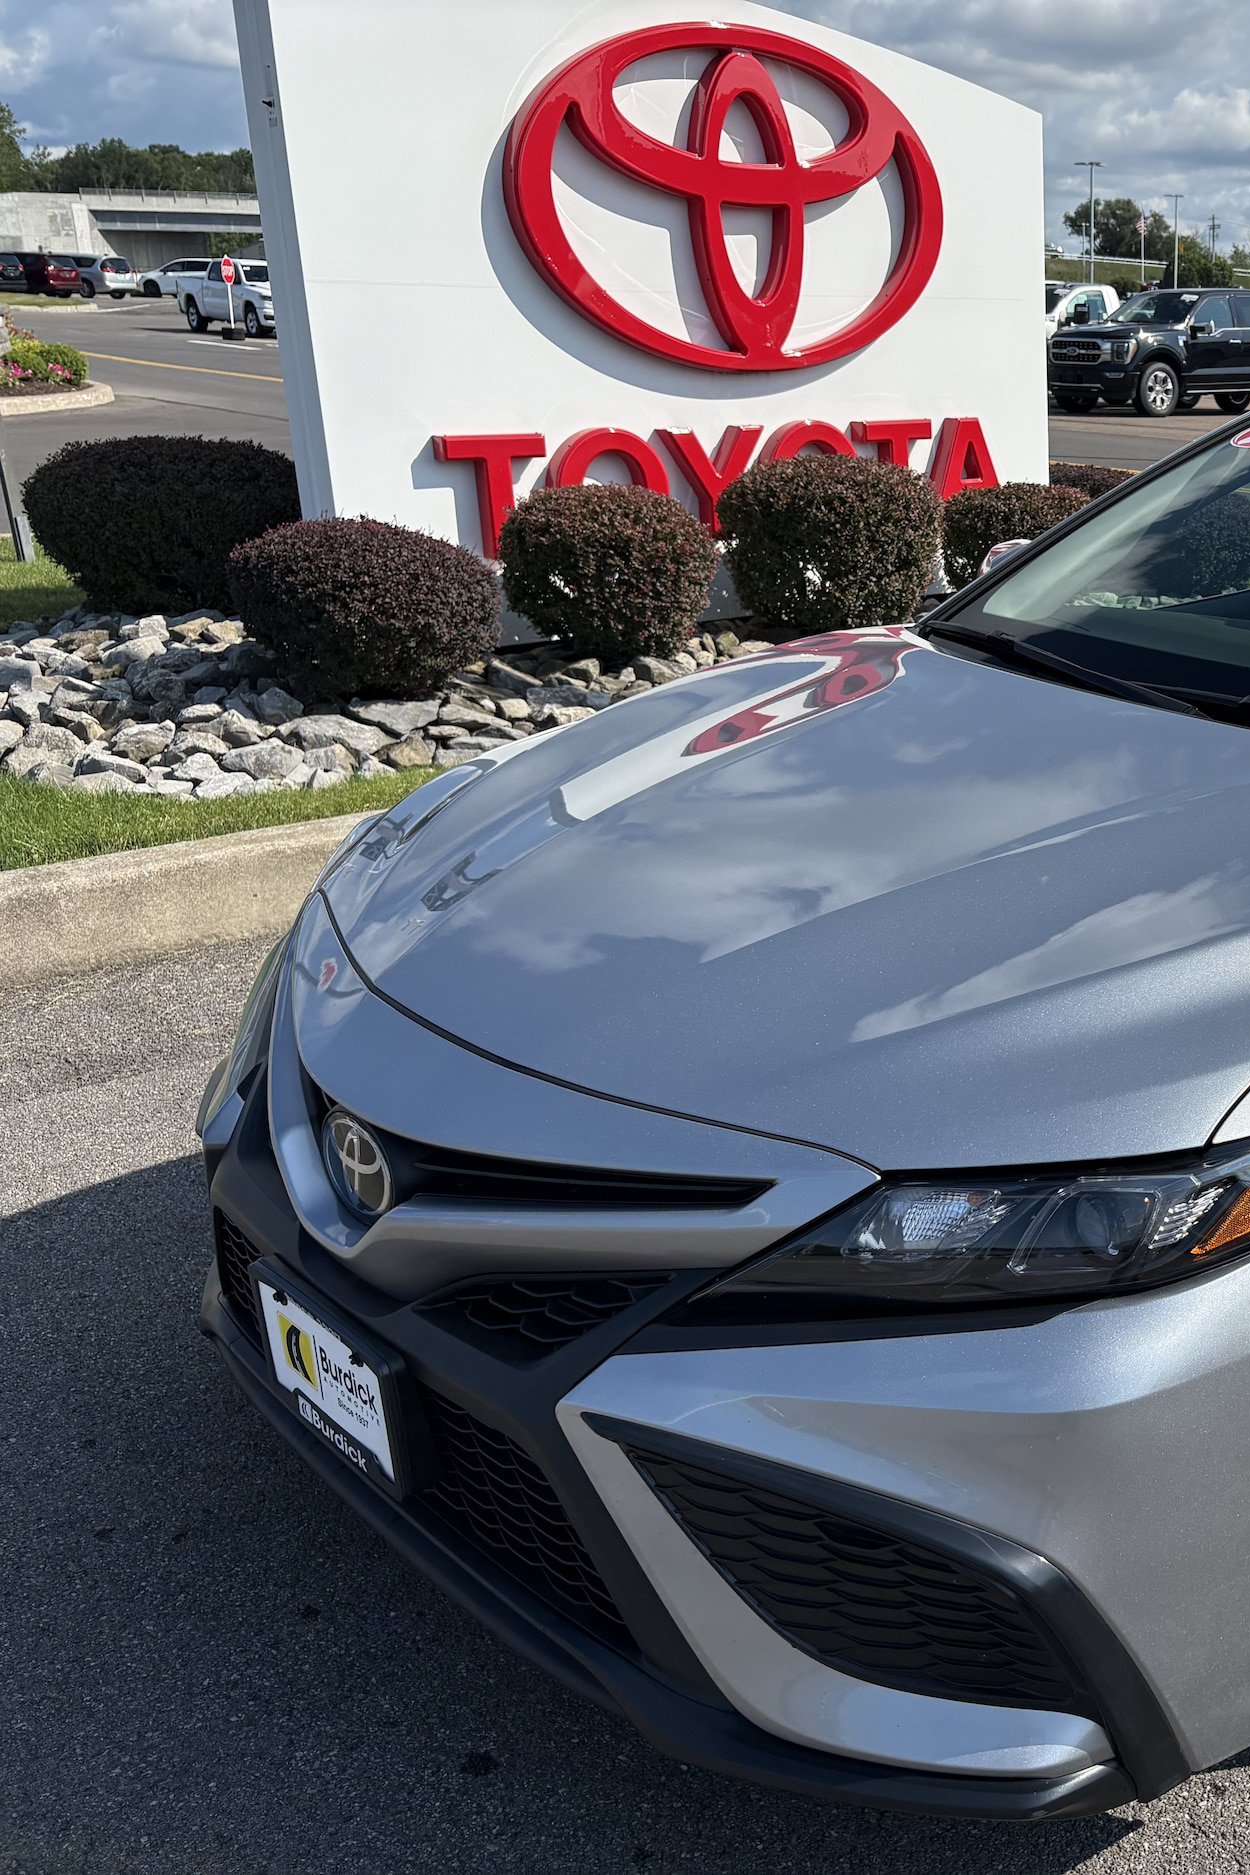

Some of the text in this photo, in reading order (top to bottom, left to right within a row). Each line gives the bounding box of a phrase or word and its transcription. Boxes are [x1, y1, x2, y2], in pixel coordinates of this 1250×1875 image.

[222, 266, 234, 277] STOP
[318, 1345, 379, 1416] Burdick
[323, 1376, 381, 1427] AUTOMOTIVE
[311, 1409, 369, 1473] Burdick
